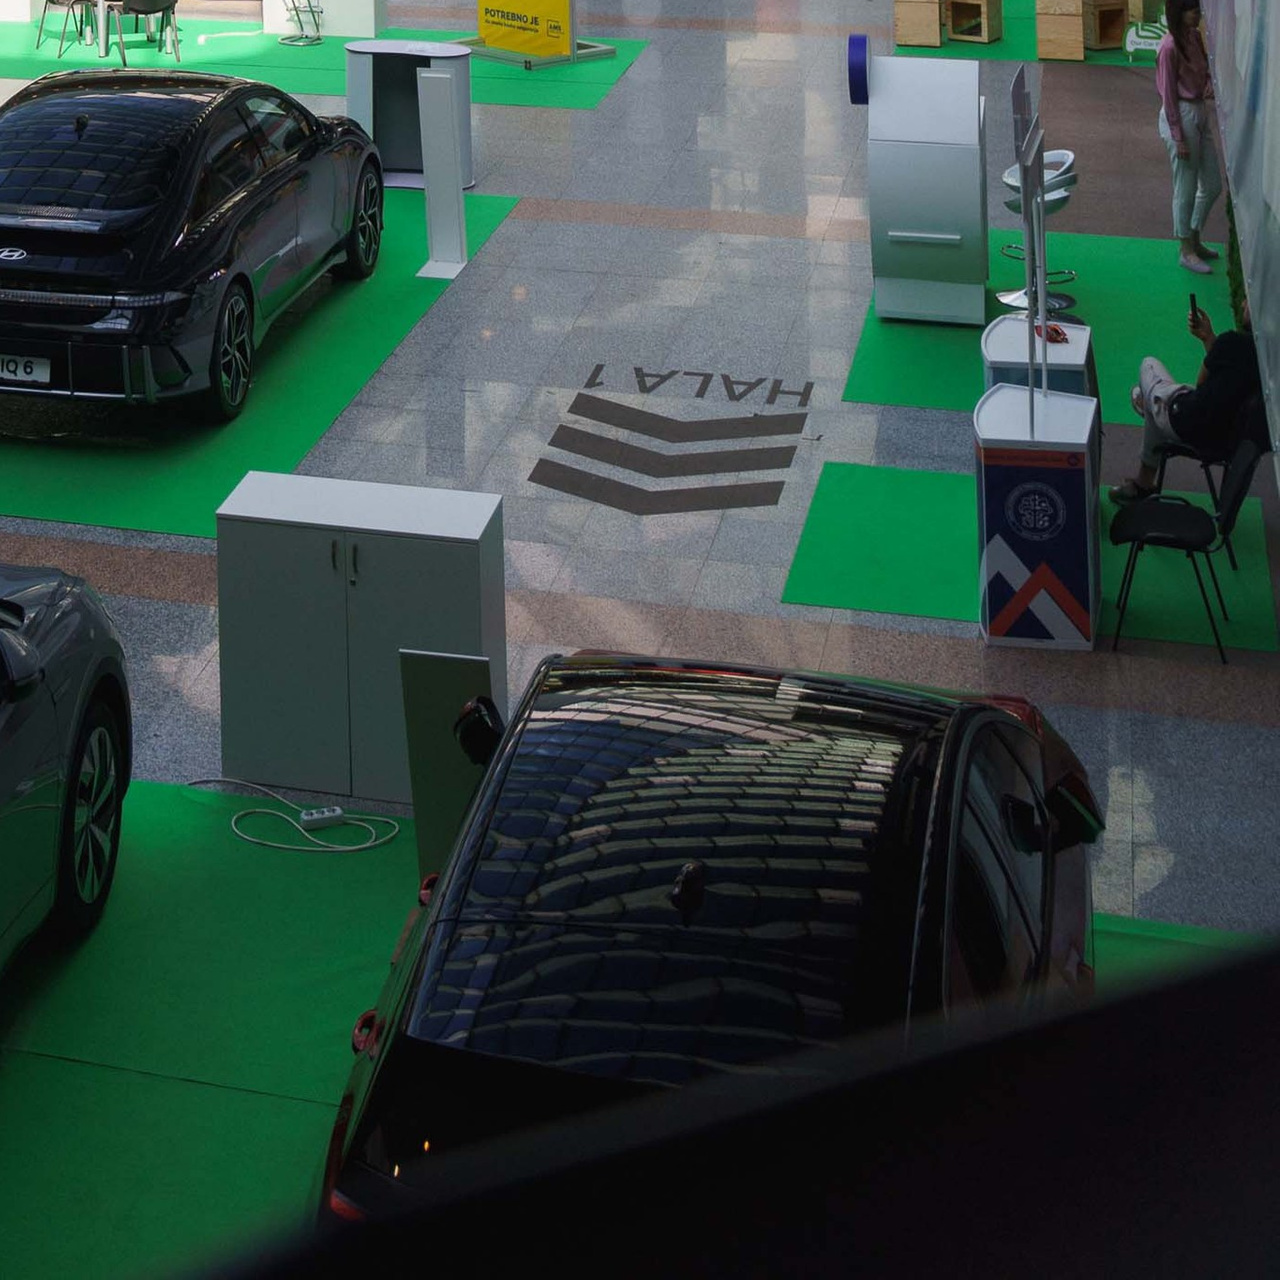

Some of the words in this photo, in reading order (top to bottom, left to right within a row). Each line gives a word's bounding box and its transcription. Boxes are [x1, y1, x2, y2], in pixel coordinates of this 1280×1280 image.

[484, 7, 528, 24] POTREBNO
[529, 14, 539, 26] JE
[23, 360, 34, 375] 6
[583, 364, 605, 388] 1
[633, 366, 815, 407] HALA
